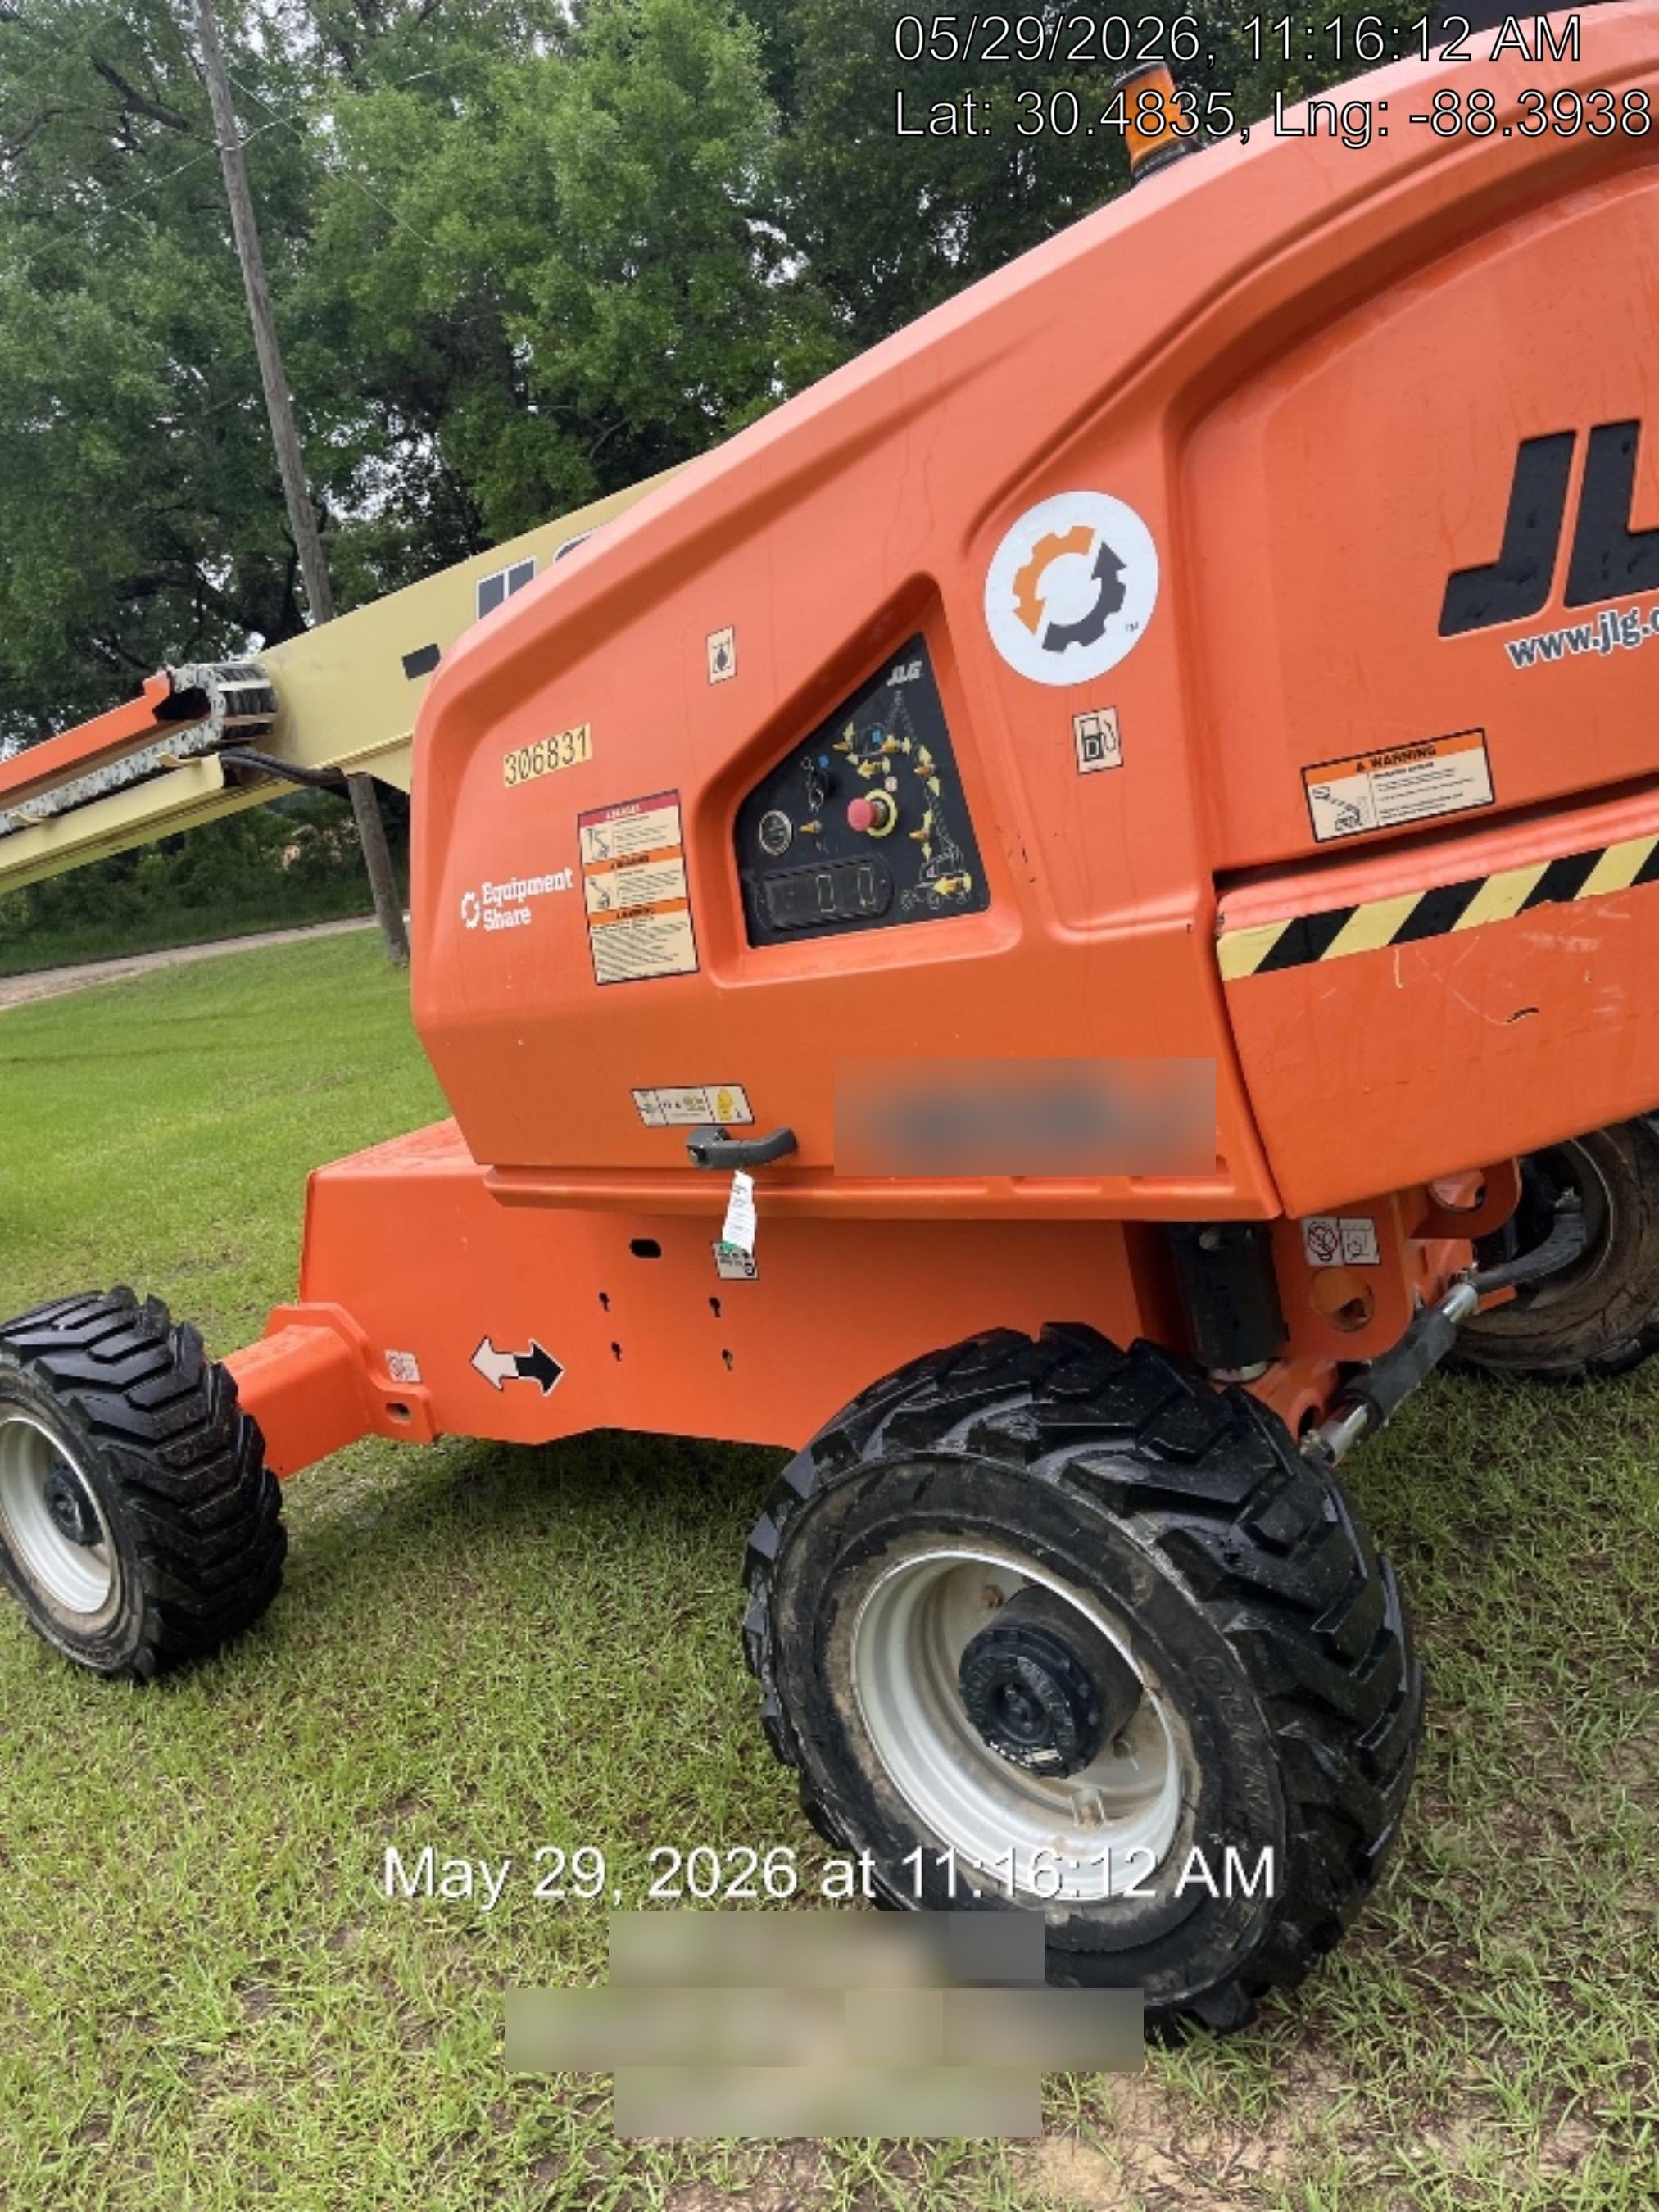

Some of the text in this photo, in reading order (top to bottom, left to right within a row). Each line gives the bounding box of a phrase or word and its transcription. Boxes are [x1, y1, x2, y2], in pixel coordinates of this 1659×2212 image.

[505, 726, 587, 785] 306831
[1370, 744, 1436, 768] WARNING
[481, 867, 573, 907] Equipment
[483, 907, 532, 932] Share
